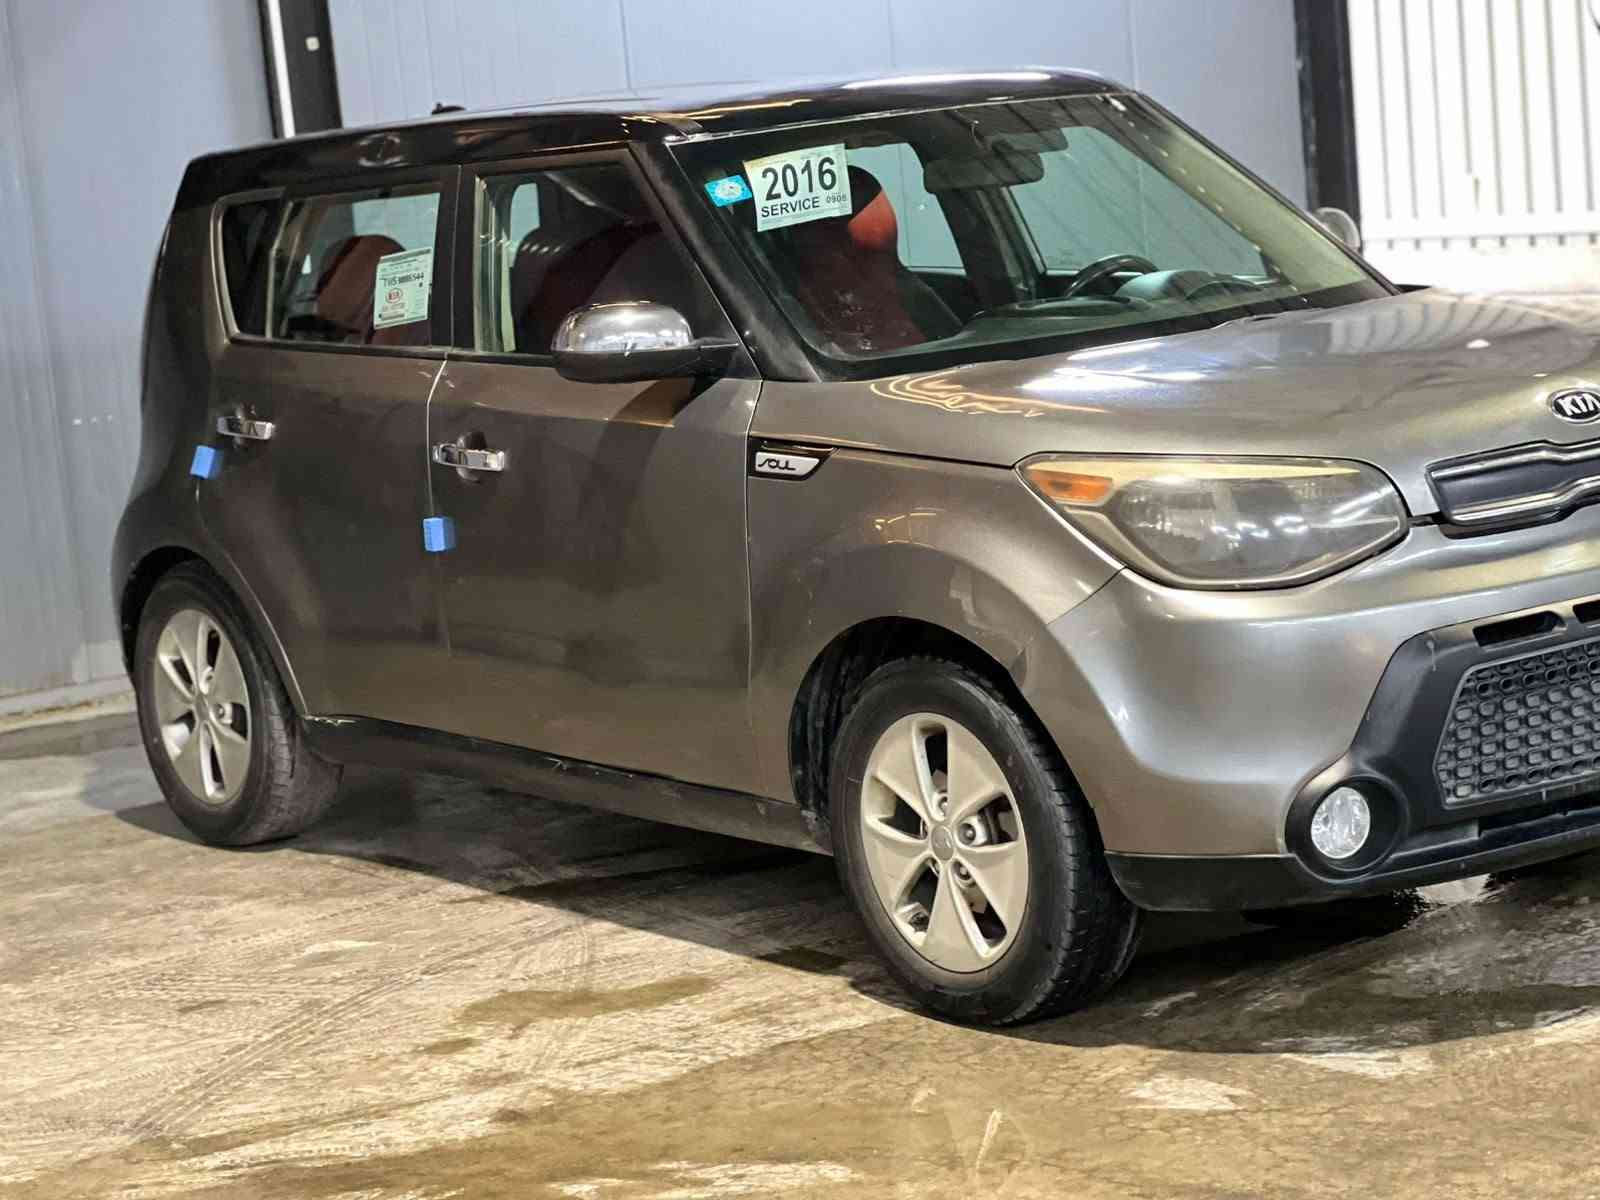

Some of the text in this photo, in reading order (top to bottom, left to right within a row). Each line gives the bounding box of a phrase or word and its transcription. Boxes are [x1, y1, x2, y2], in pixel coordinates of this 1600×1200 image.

[761, 156, 837, 201] 2016
[761, 196, 820, 218] SERVICE
[1557, 393, 1600, 416] KIA
[758, 458, 796, 471] SOUL
